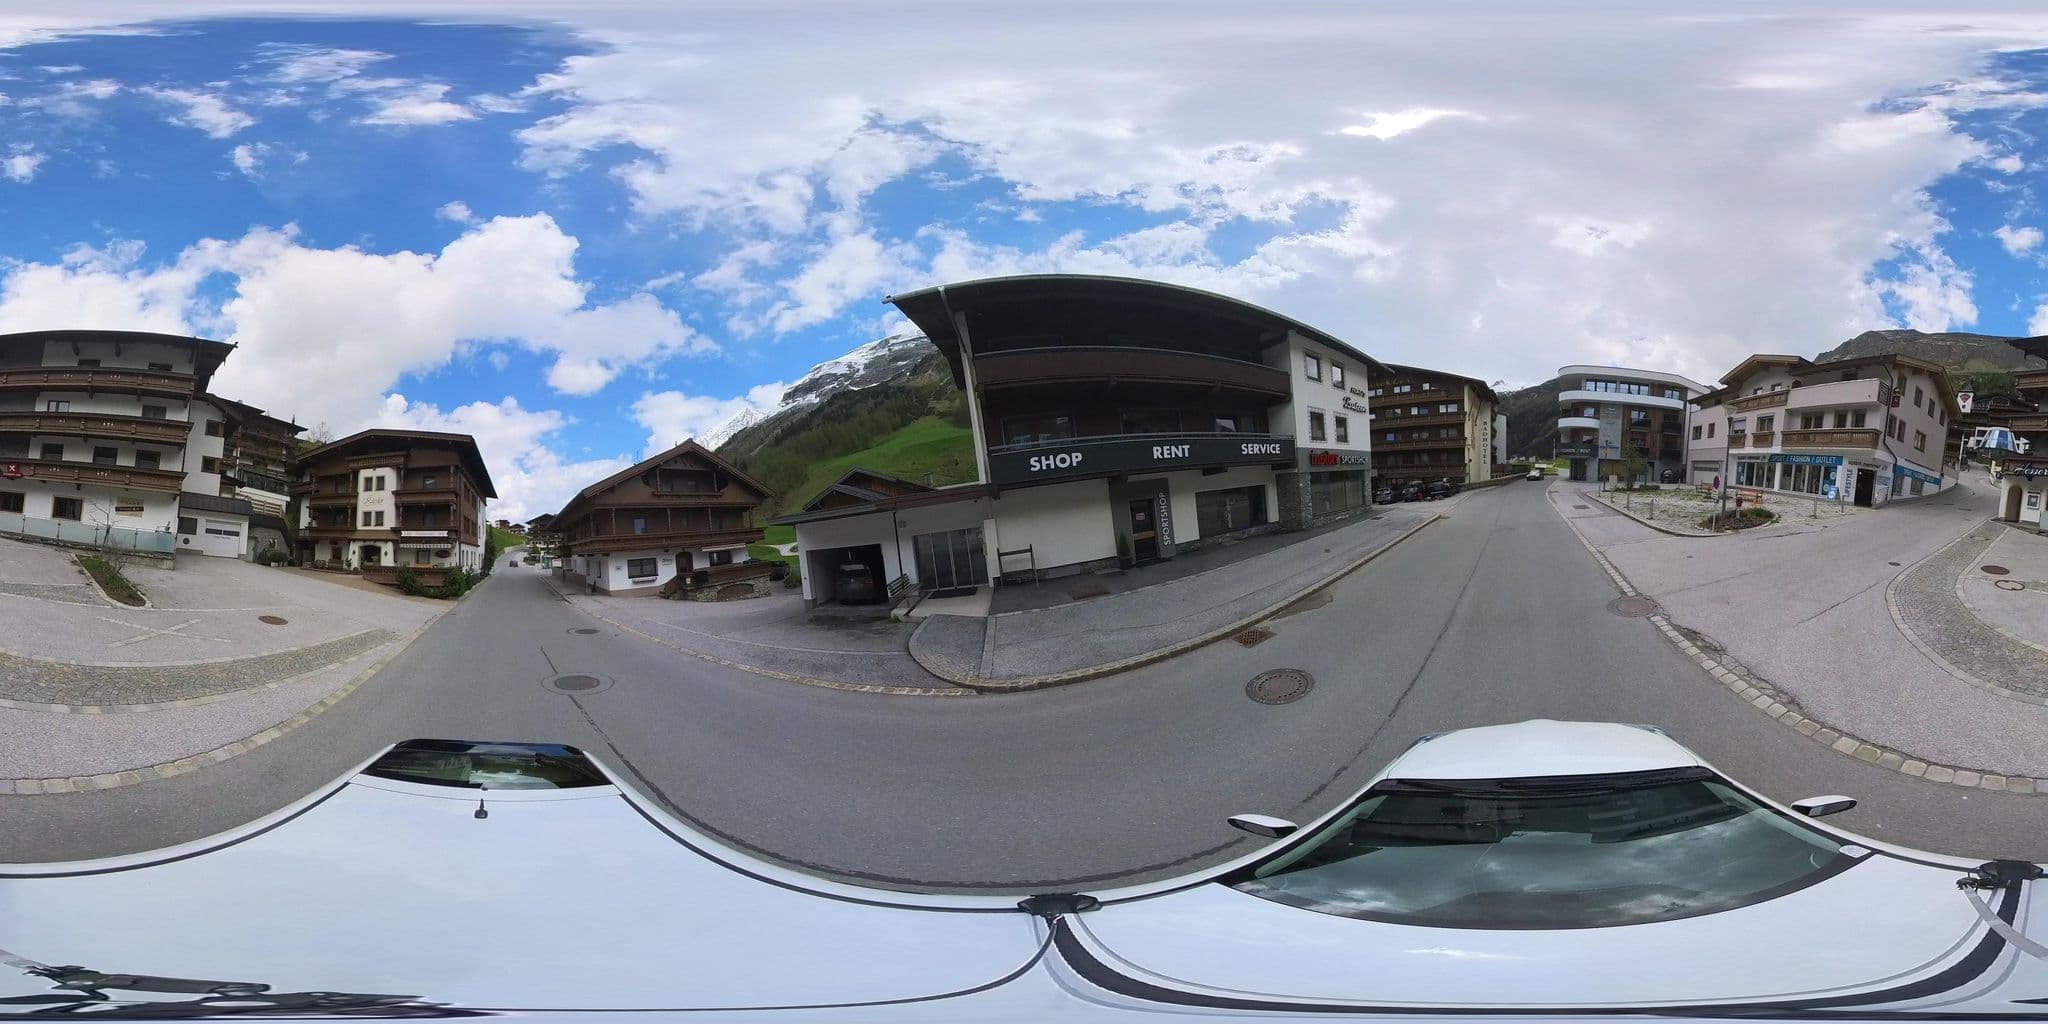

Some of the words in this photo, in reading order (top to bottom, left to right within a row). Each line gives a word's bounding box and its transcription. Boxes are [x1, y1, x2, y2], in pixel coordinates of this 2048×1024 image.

[1153, 444, 1190, 460] RENT
[1241, 443, 1281, 455] SERVICE
[1029, 452, 1083, 472] SHOP
[1789, 455, 1811, 463] FASHION
[1815, 456, 1836, 464] OUTLET
[1159, 492, 1171, 546] SPORTSHOP
